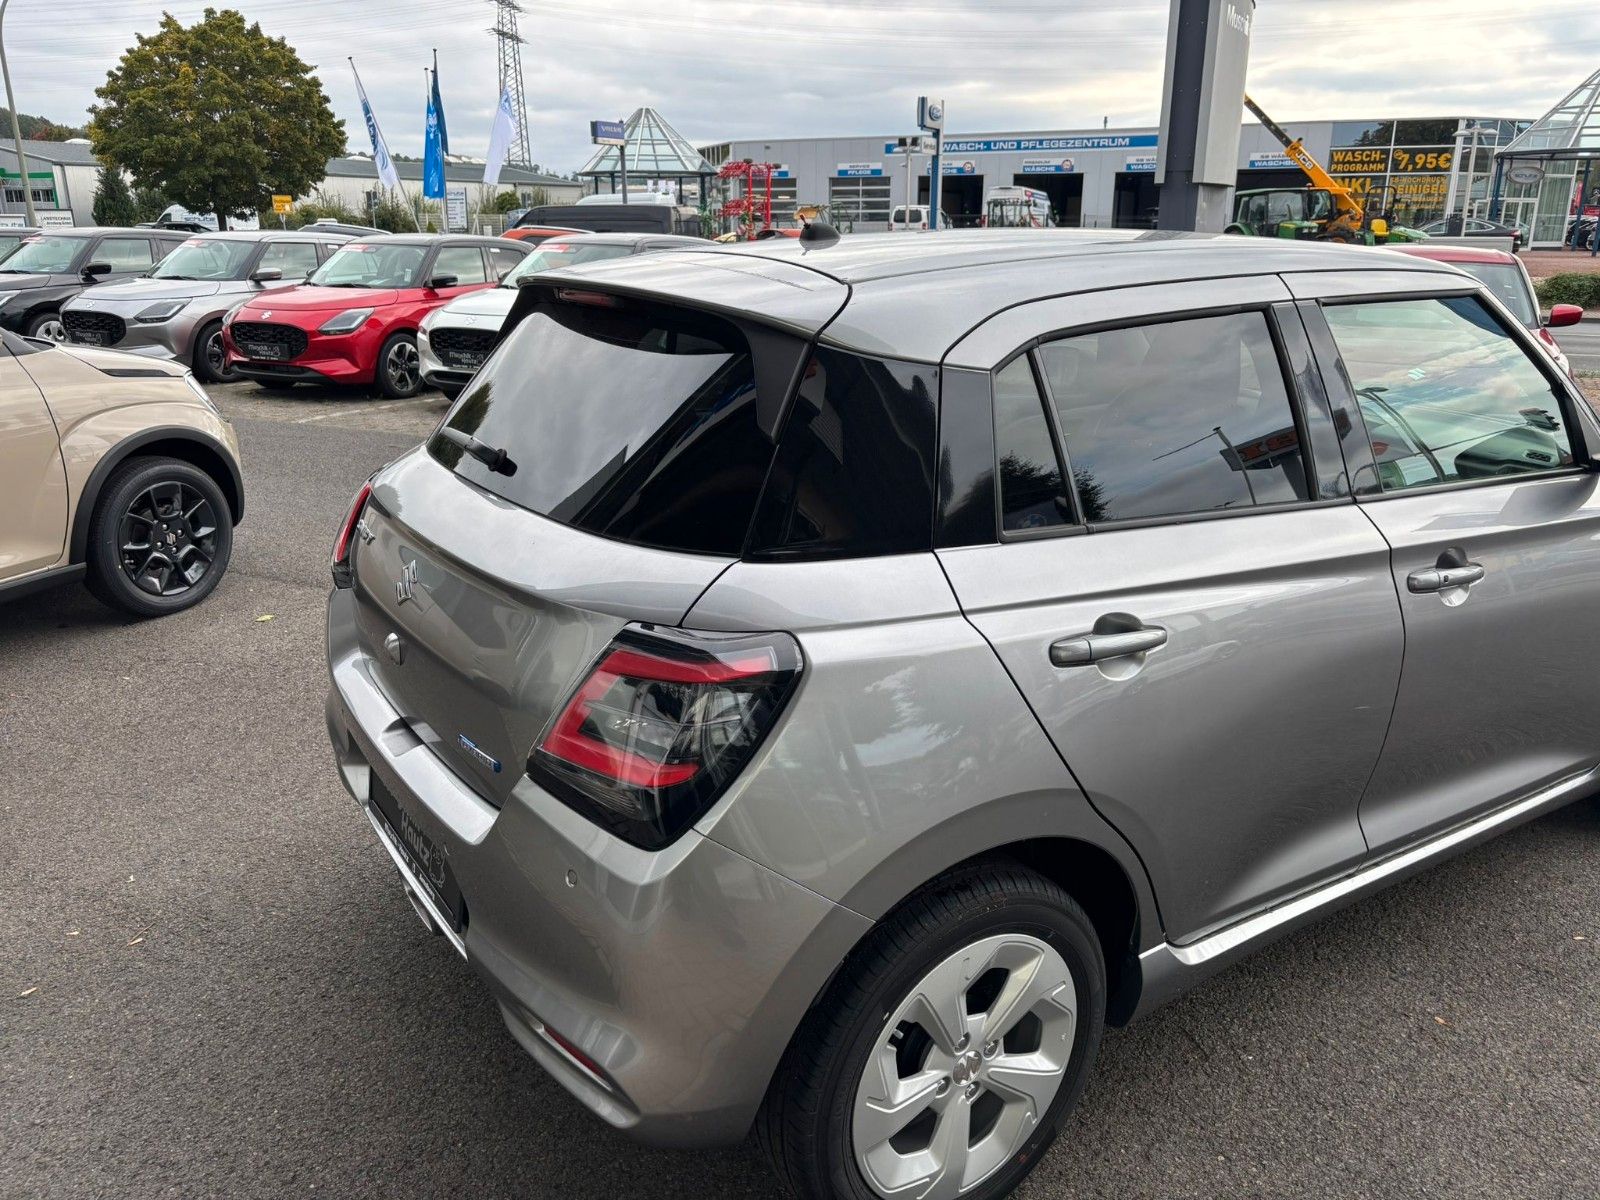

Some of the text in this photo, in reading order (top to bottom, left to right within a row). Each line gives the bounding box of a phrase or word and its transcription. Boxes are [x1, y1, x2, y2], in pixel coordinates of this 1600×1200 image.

[991, 141, 1017, 150] UND
[1020, 137, 1130, 149] PFLEGEZENTRUM
[1295, 152, 1315, 170] JCB
[1332, 150, 1386, 162] WASCH-
[1398, 153, 1452, 171] 7,95€
[1331, 163, 1385, 172] PROGRAMM
